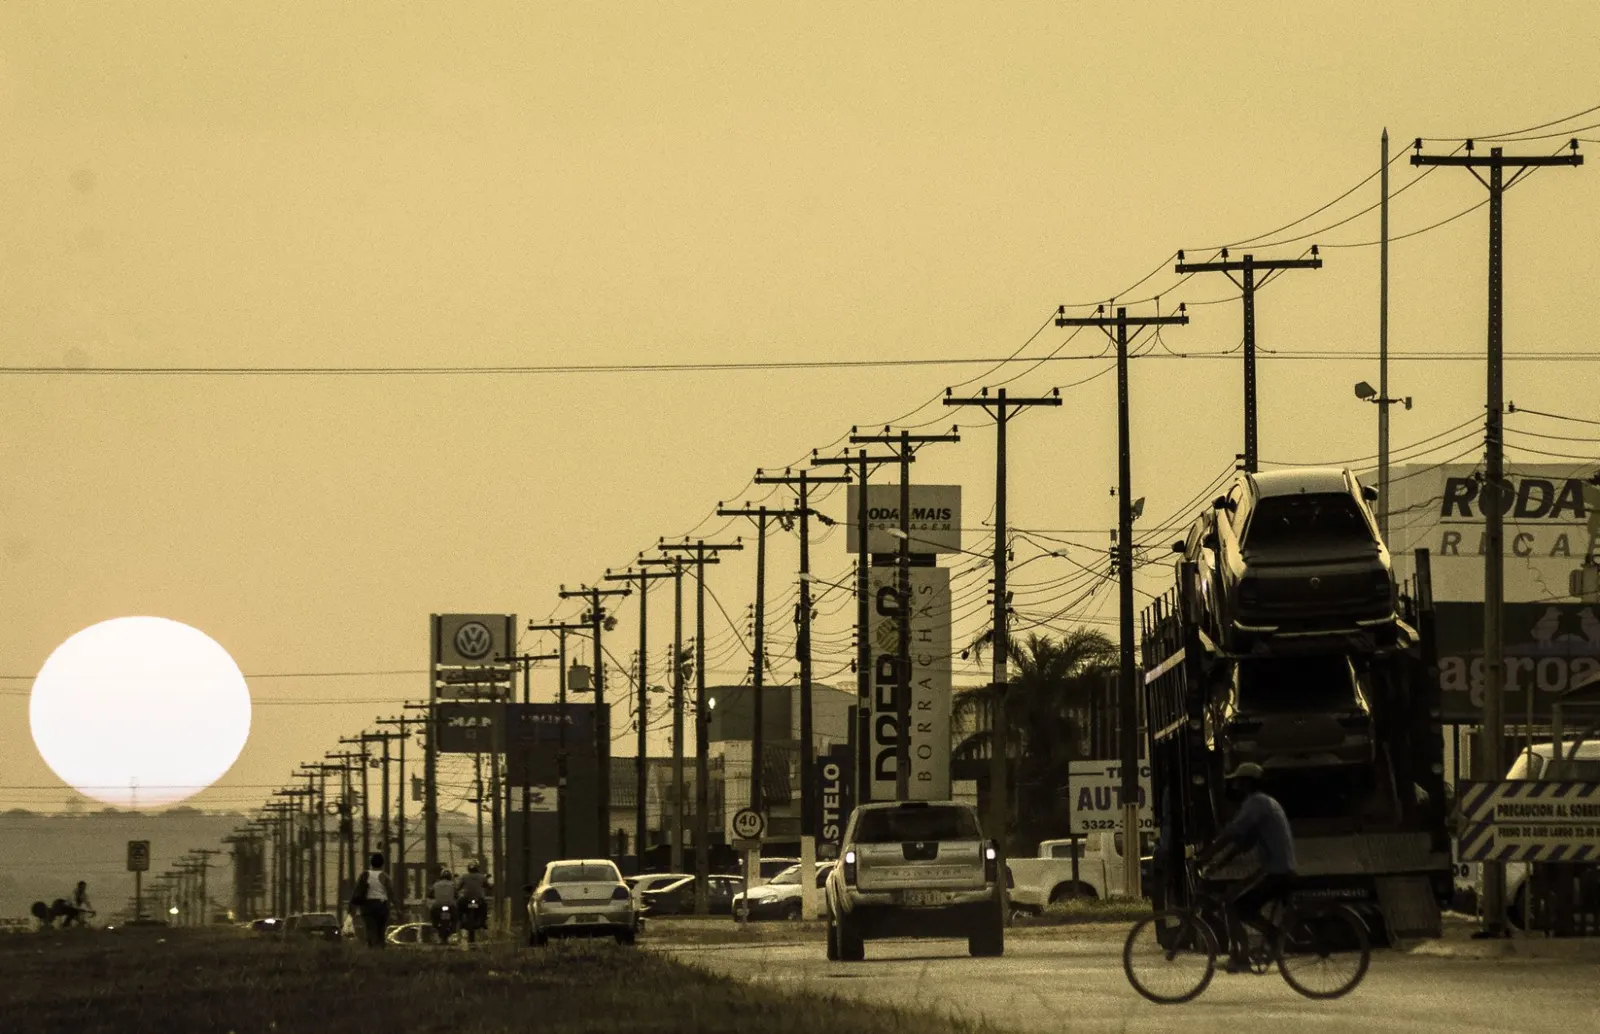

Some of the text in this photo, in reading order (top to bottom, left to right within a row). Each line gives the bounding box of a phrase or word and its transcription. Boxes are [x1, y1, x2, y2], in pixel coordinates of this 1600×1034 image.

[858, 507, 952, 520] ODA MAIS
[917, 584, 933, 782] BORRACHAS
[822, 763, 840, 846] STELO
[1497, 803, 1553, 817] PRECAUCION
[1556, 804, 1568, 816] AL
[739, 814, 756, 827] 40
